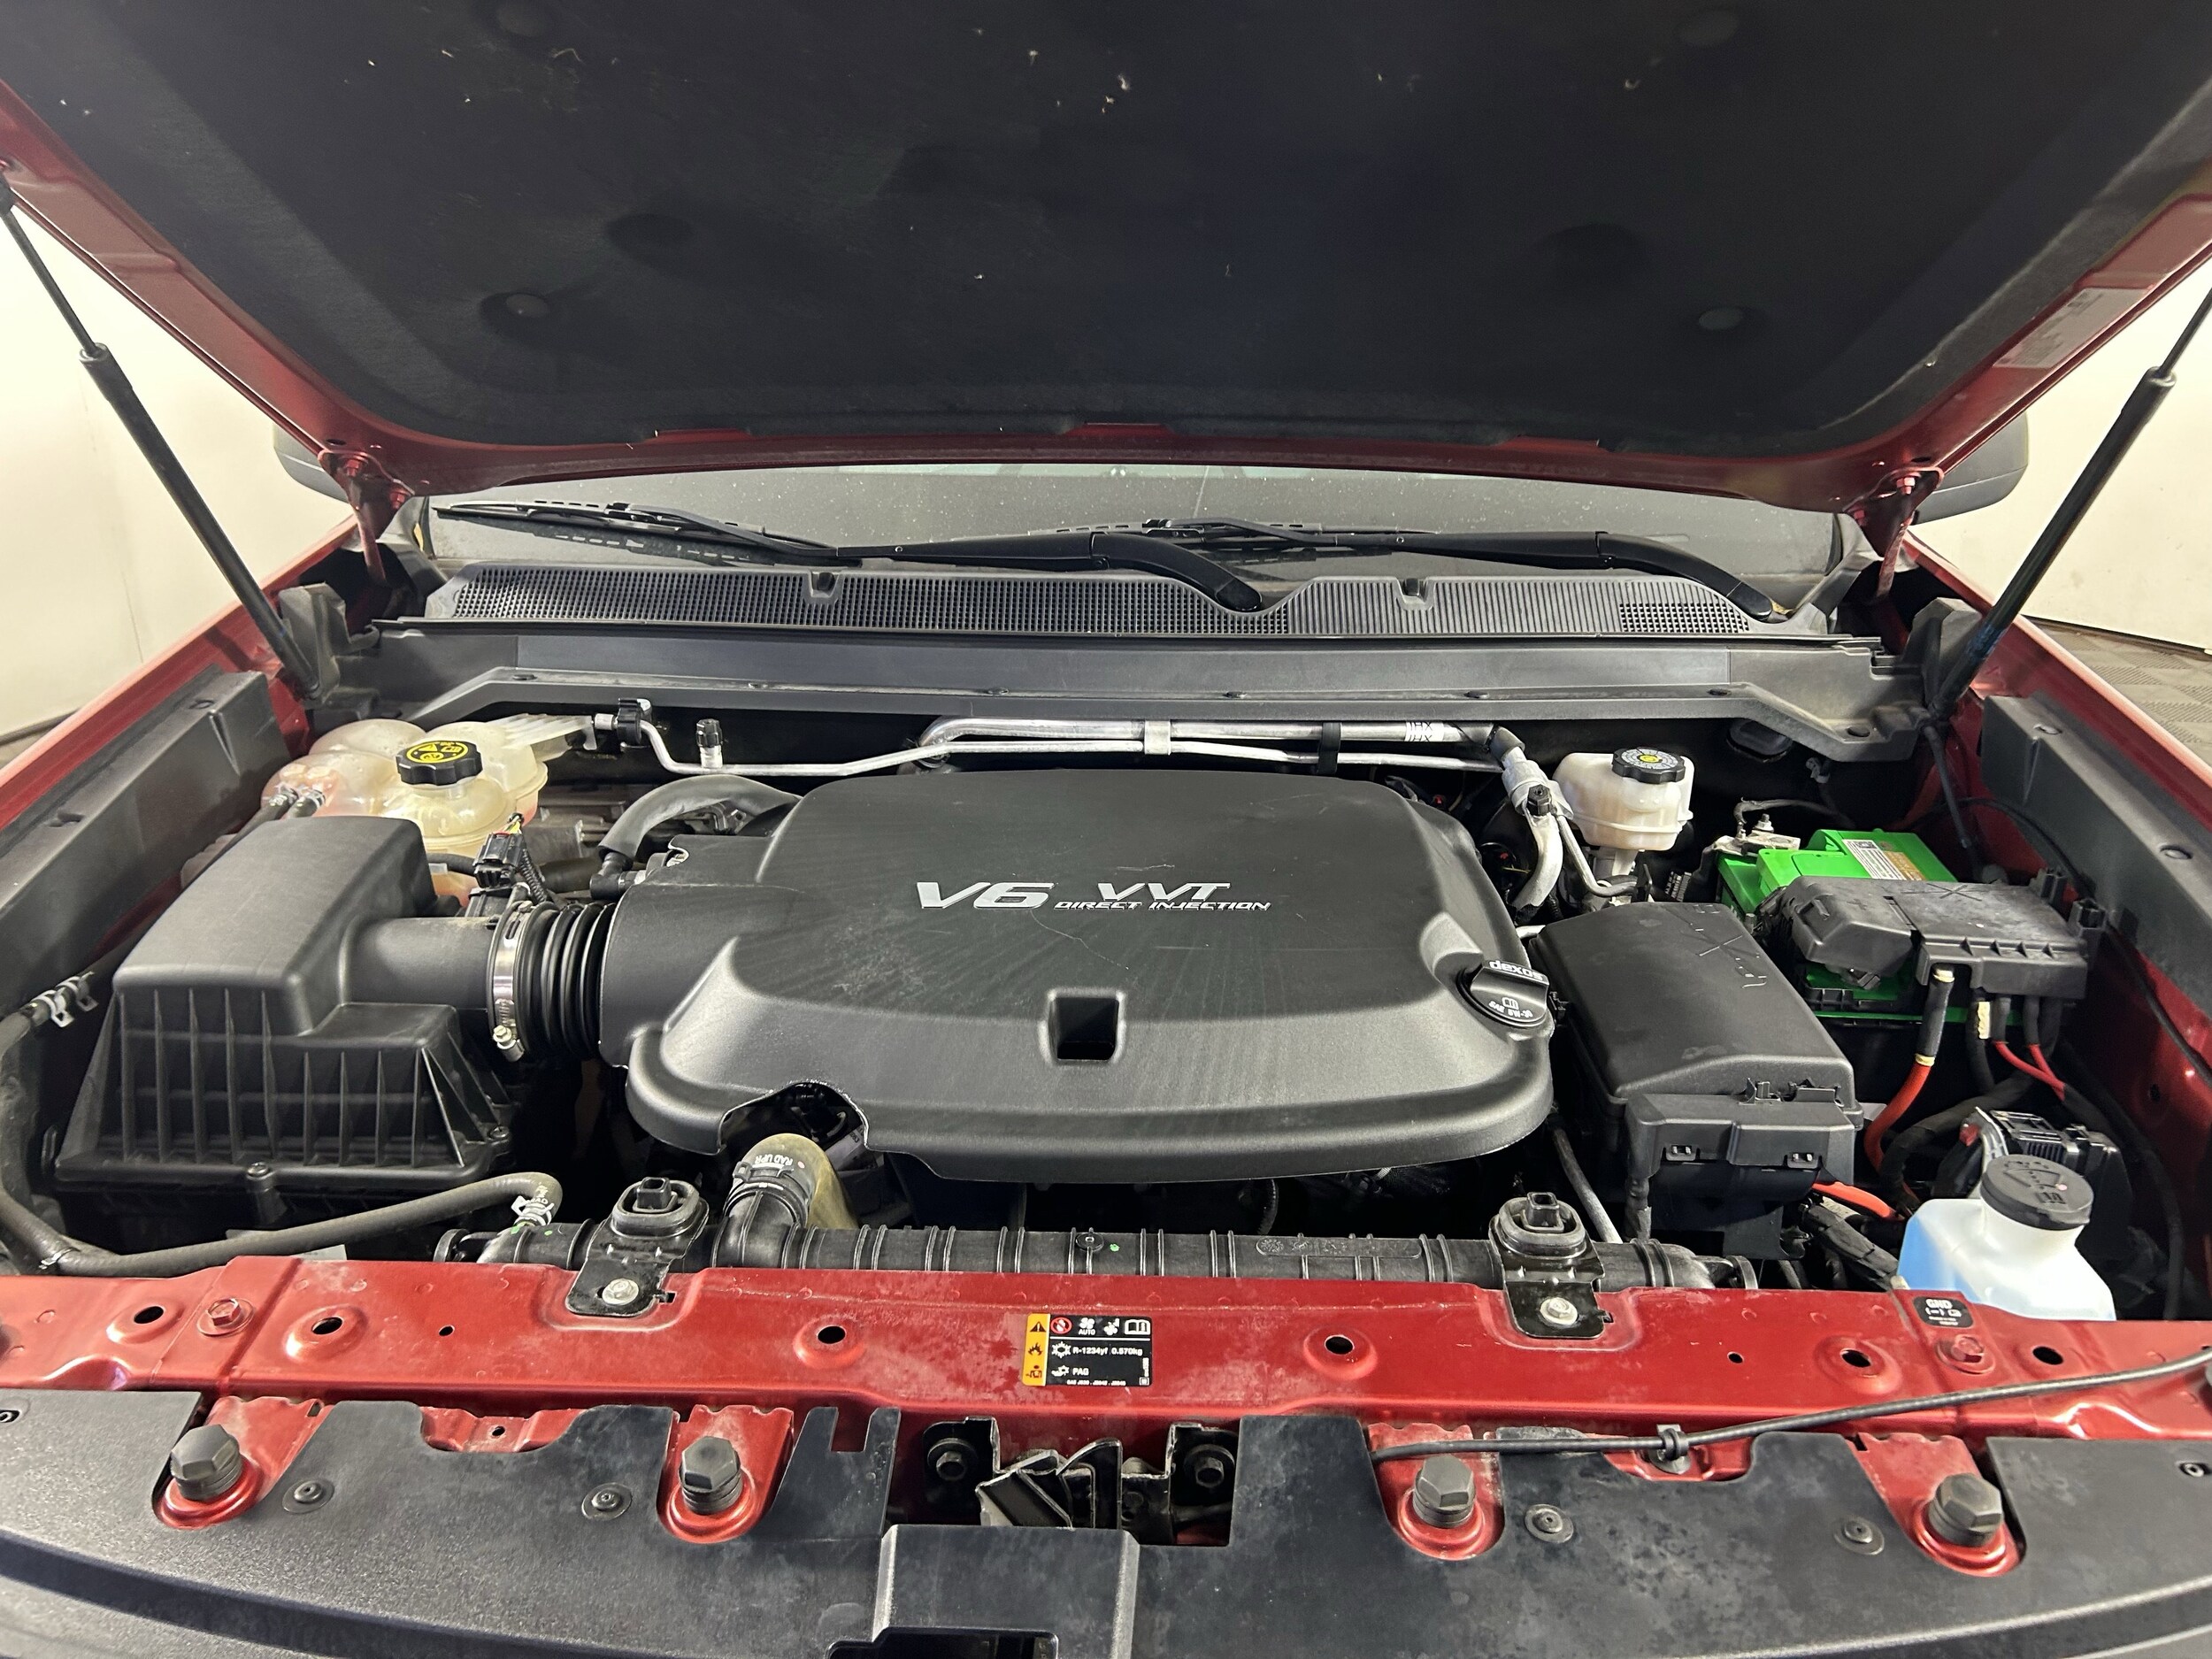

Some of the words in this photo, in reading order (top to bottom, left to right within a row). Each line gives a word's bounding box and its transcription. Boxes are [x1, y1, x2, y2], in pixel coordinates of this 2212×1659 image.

[917, 882, 1055, 910] V6
[1097, 882, 1232, 902] VVT
[1053, 901, 1143, 910] DIRECT
[1148, 901, 1271, 911] INJECTION
[1489, 960, 1543, 981] dexos
[1488, 1001, 1505, 1013] SAE
[754, 1153, 773, 1164] UPR
[774, 1154, 794, 1166] RAD
[1072, 1347, 1108, 1356] R-1234yf
[1071, 1367, 1089, 1377] PAG
